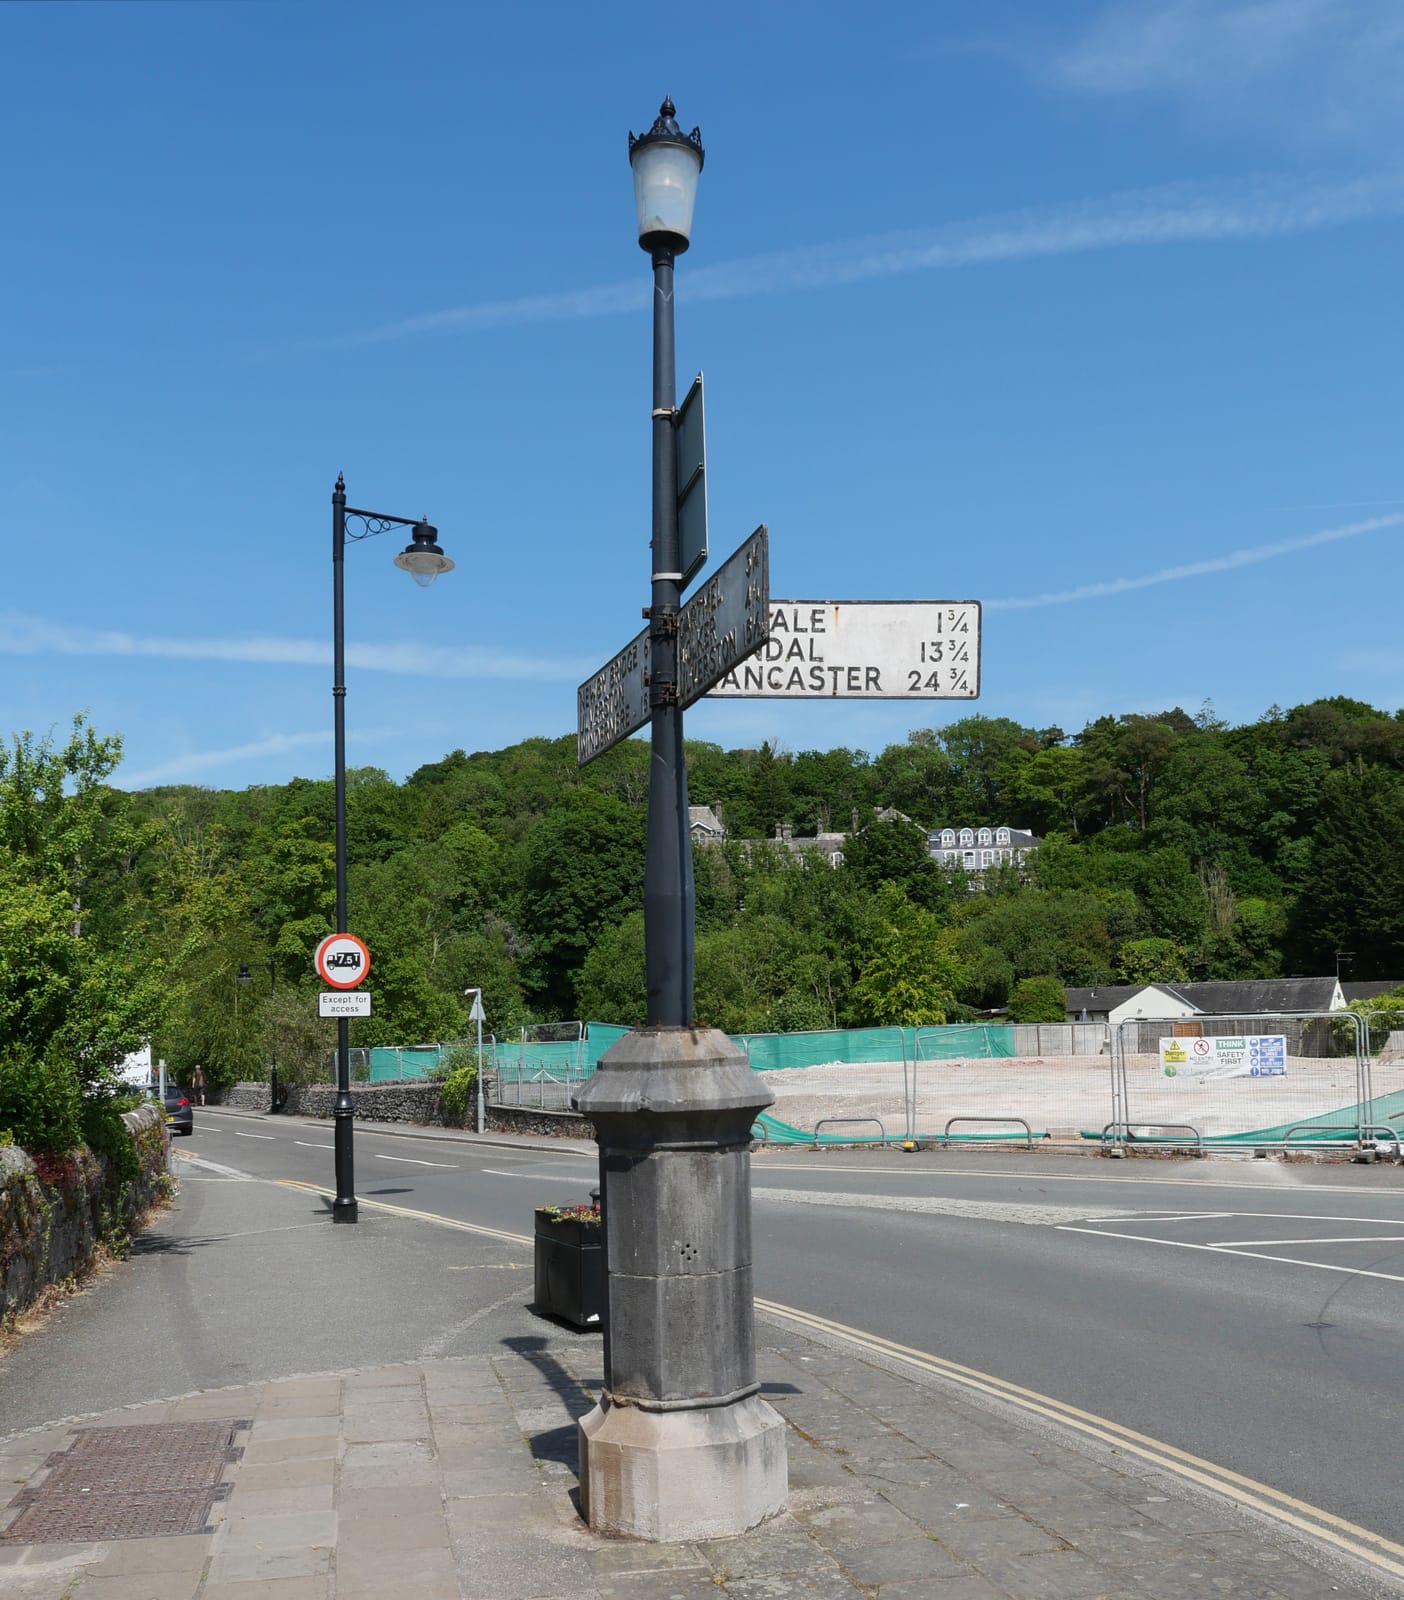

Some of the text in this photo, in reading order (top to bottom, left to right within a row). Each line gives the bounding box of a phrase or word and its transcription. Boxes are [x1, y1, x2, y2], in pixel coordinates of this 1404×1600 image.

[771, 608, 826, 633] ALE
[580, 672, 607, 713] NEWBY
[610, 644, 638, 690] BRIDGE
[712, 665, 883, 691] ANCASTER
[580, 684, 625, 736] ULVERSTON
[579, 703, 631, 759] WINDERMERE
[322, 995, 367, 1005] Except for
[330, 1005, 360, 1013] access
[1218, 1040, 1245, 1048] THINK
